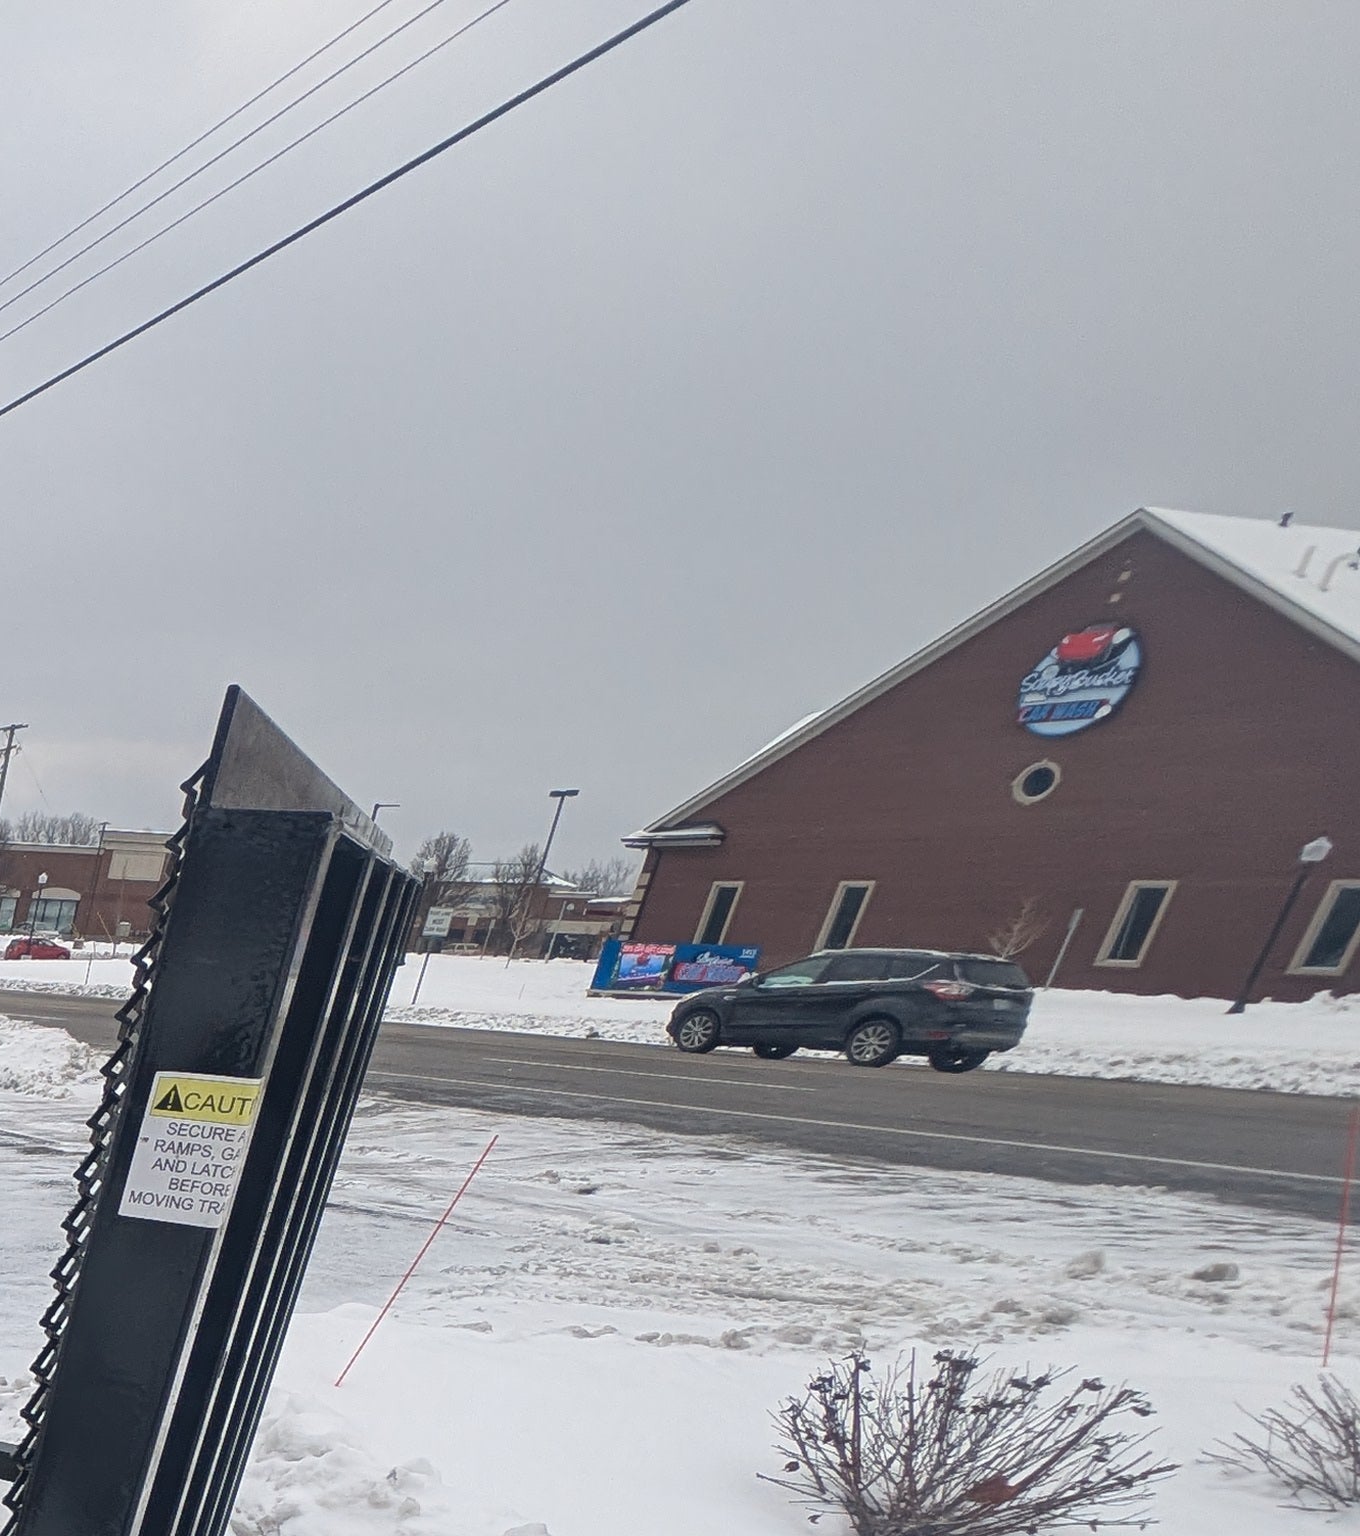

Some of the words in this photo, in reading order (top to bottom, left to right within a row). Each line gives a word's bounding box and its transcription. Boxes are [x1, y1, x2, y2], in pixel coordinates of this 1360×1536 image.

[1051, 700, 1101, 719] WASH
[166, 1122, 237, 1142] SECURE
[153, 1139, 215, 1161] RAMPS,
[151, 1157, 187, 1173] AND
[168, 1177, 231, 1197] BEFORE
[128, 1190, 194, 1211] MOVING
